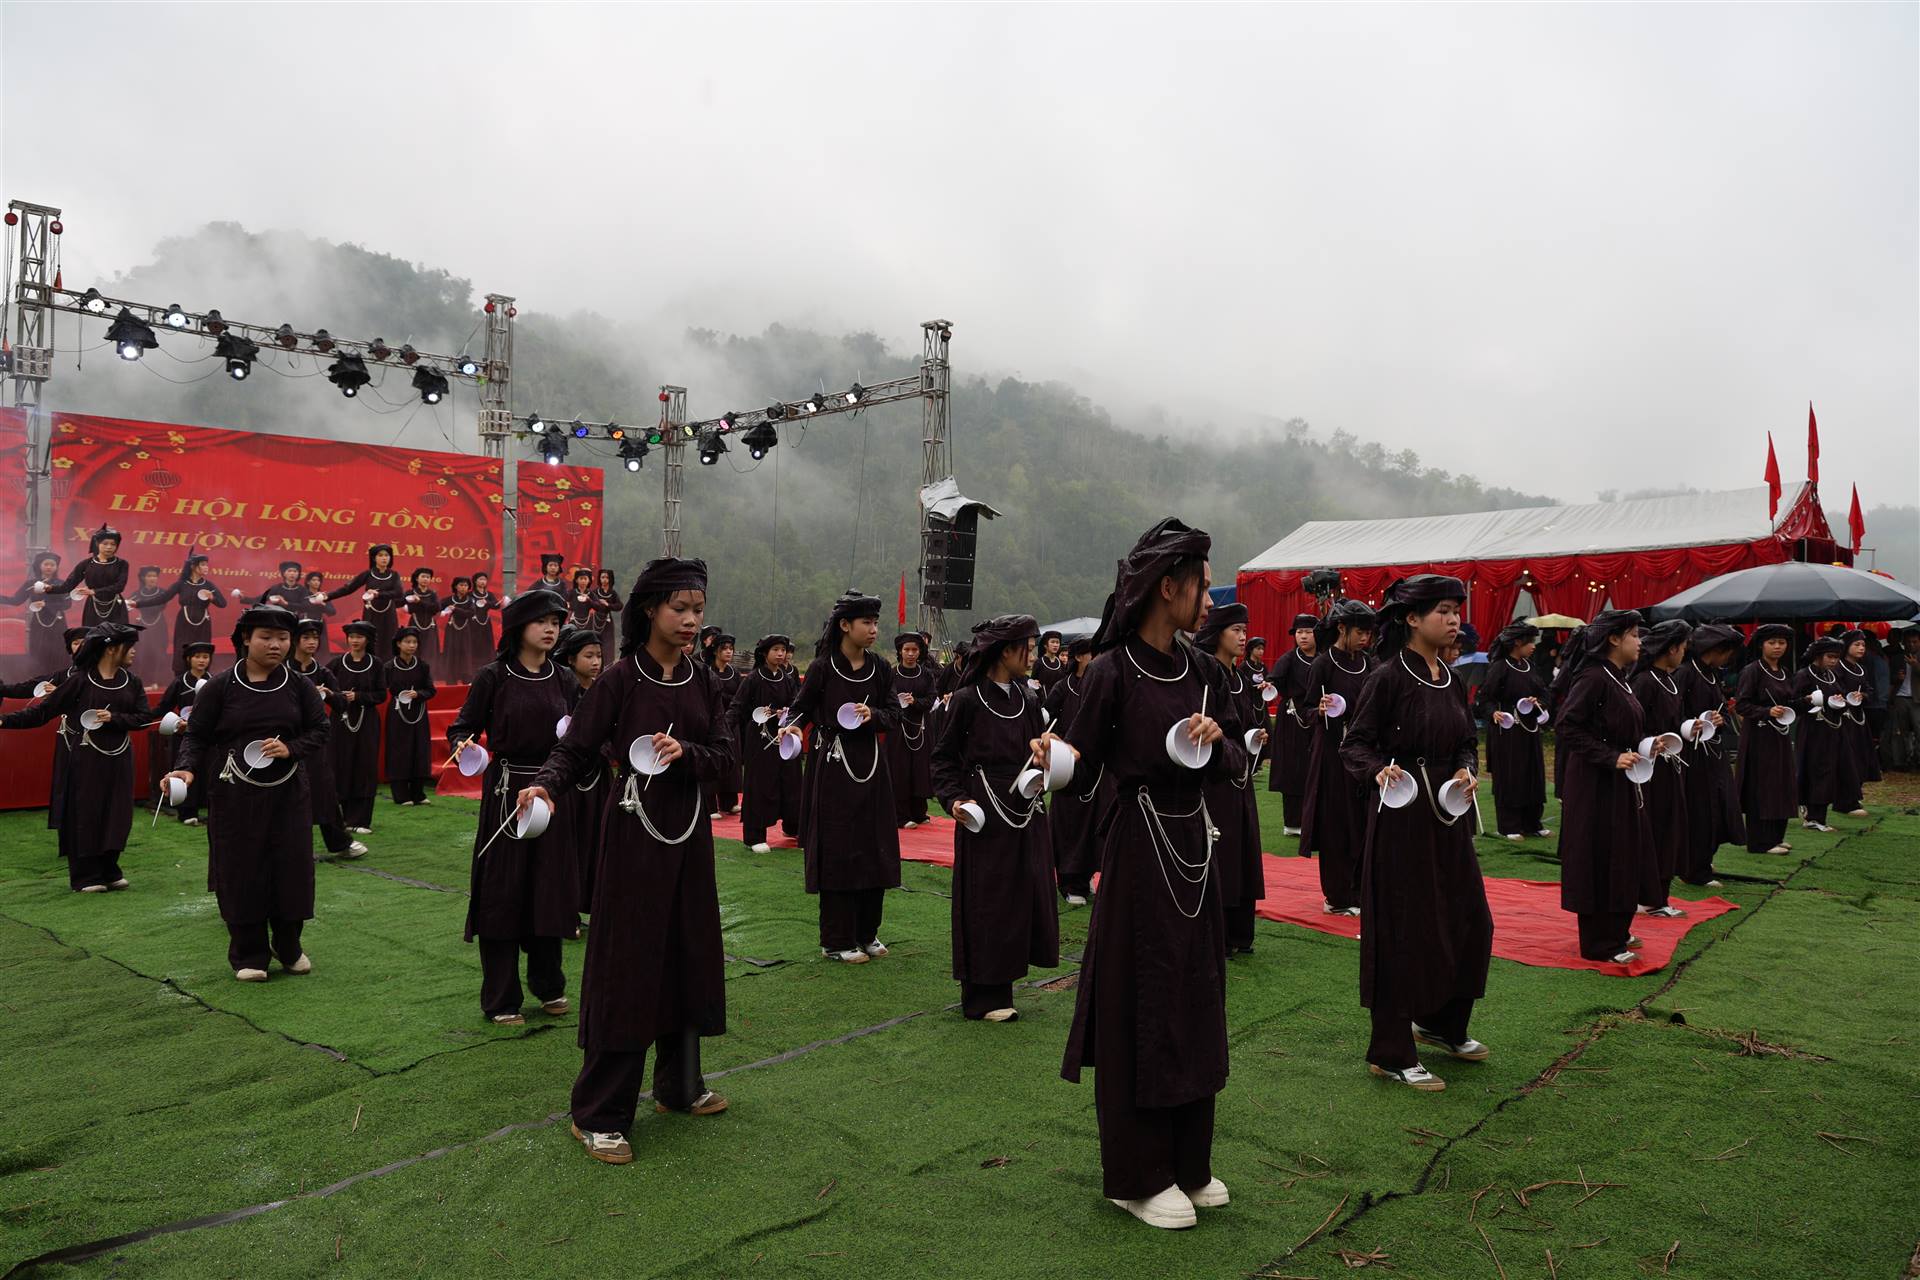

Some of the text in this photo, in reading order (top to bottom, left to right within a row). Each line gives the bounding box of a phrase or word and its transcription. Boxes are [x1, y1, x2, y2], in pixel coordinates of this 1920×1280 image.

[108, 489, 454, 531] LỄ HỘI LỒNG TỒNG
[133, 530, 267, 551] THƯỢNG
[275, 536, 357, 554] MINH
[435, 546, 491, 561] 2026
